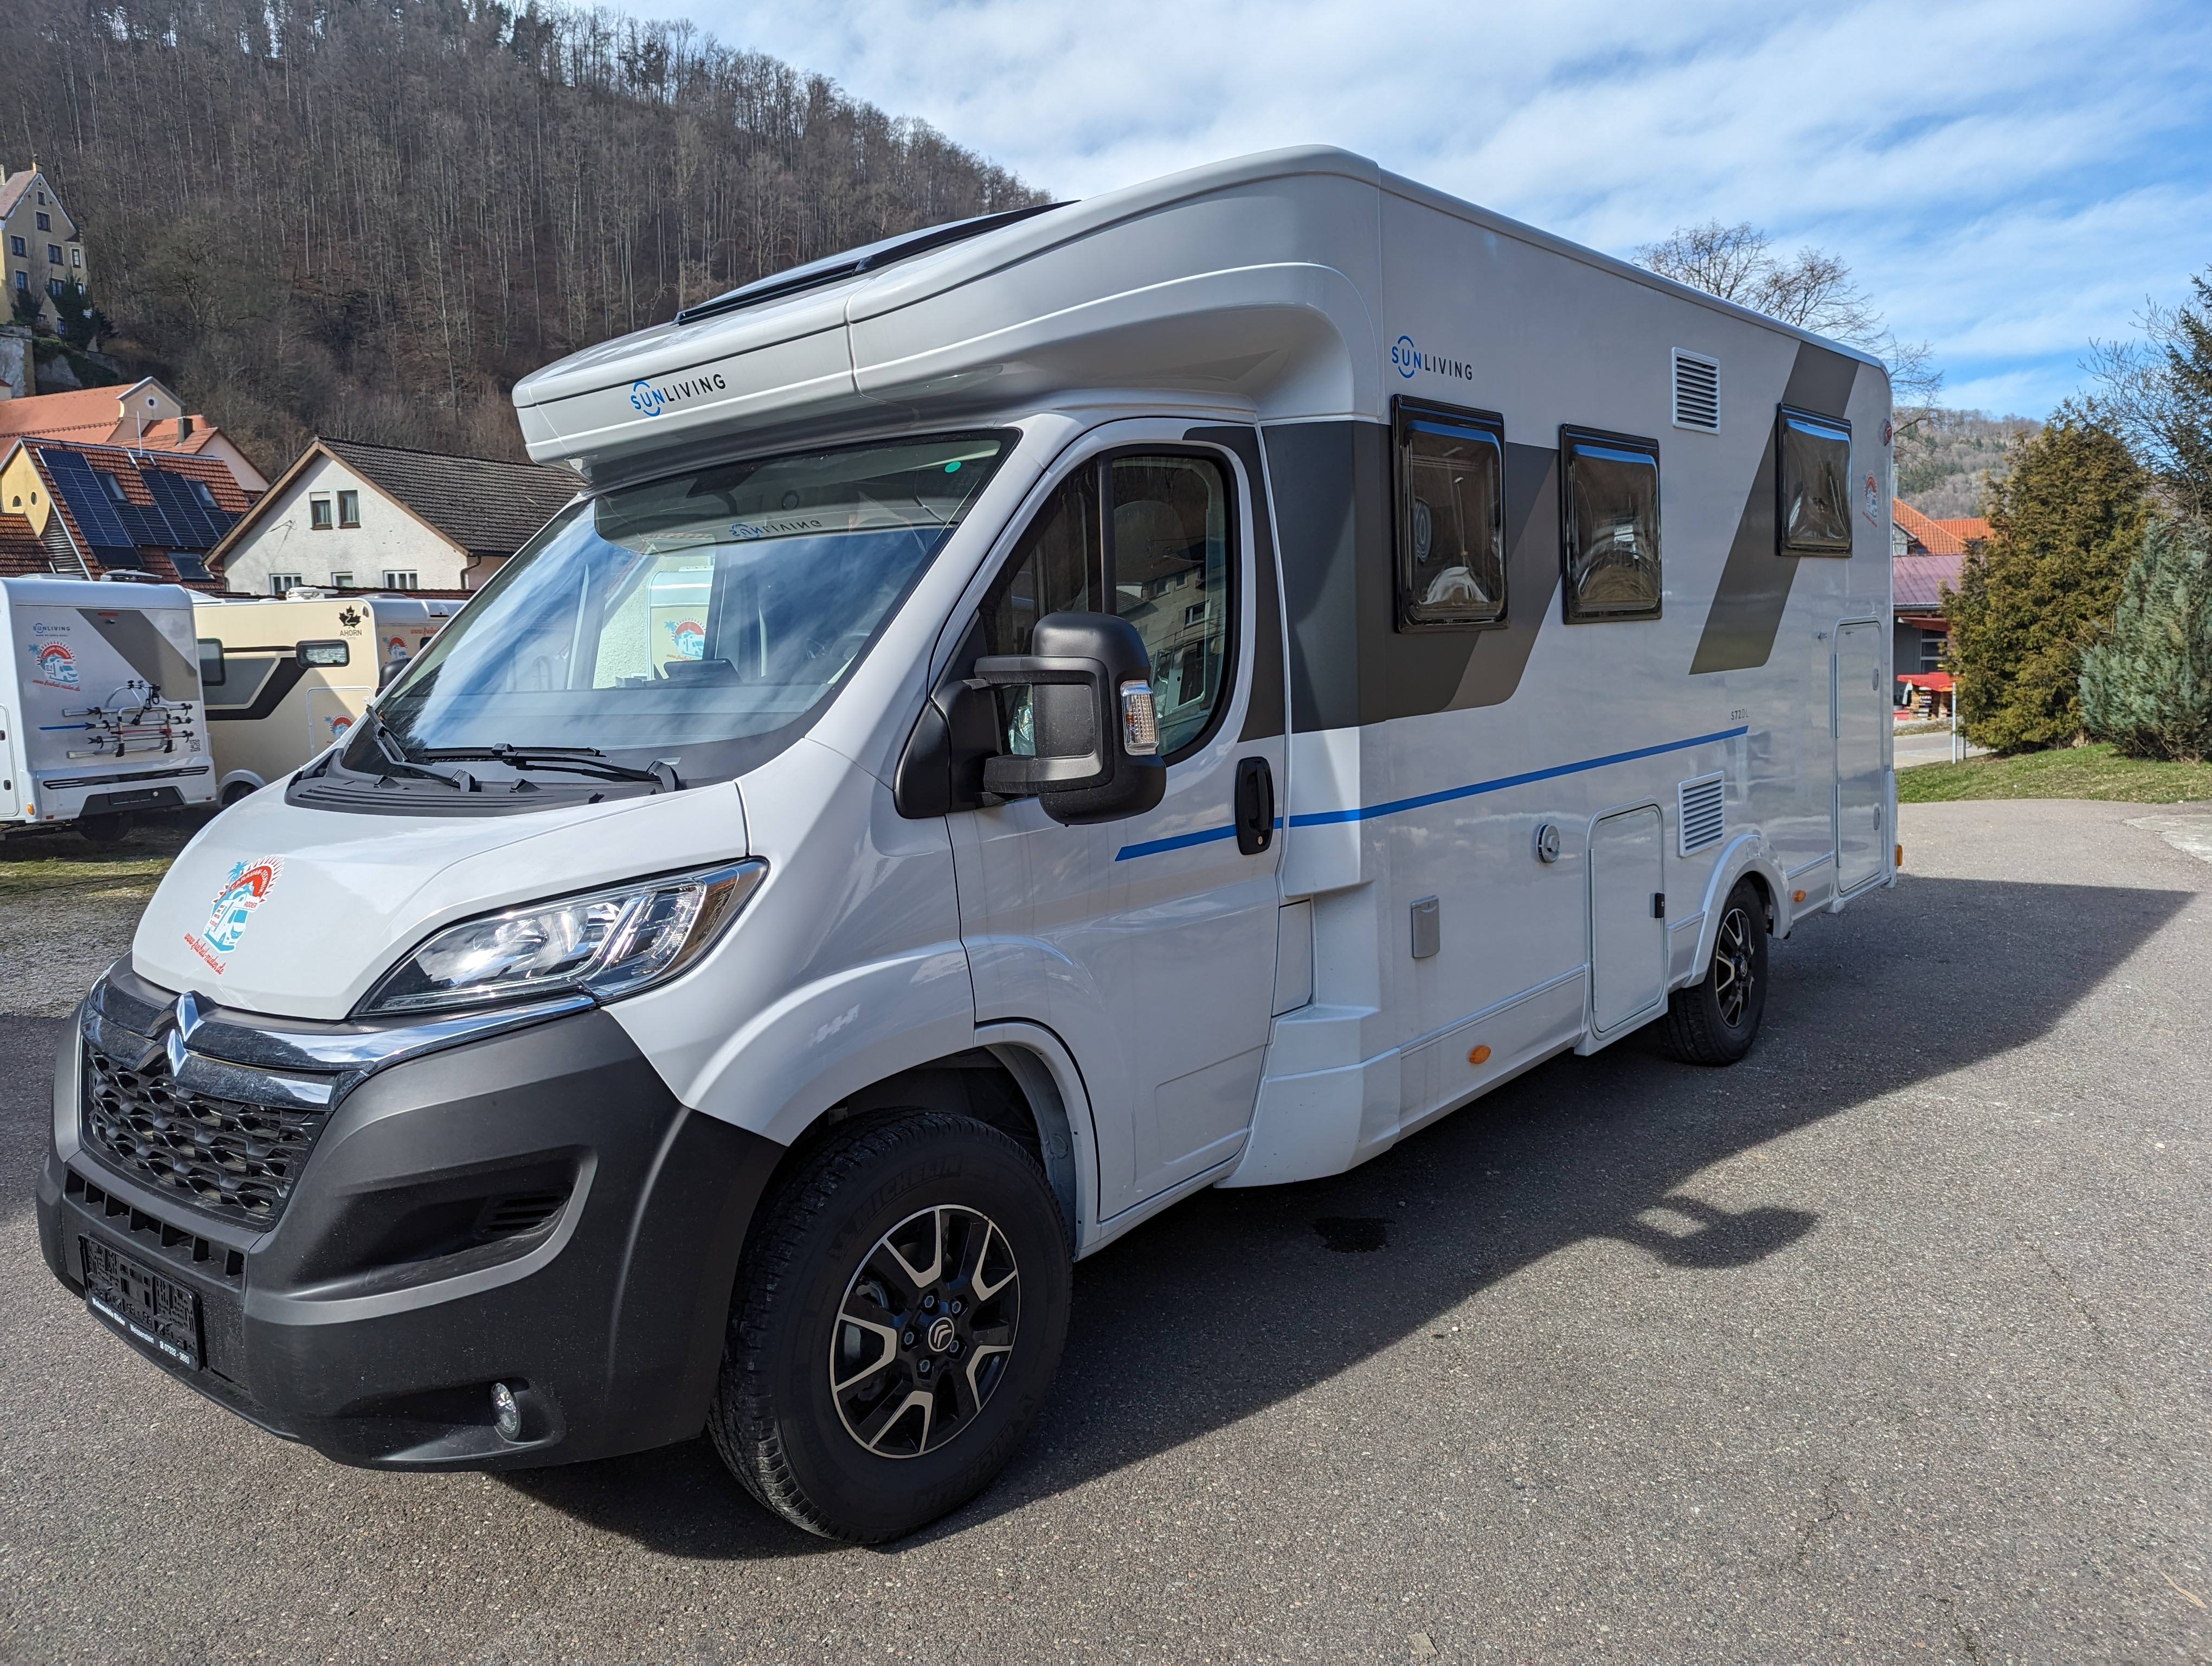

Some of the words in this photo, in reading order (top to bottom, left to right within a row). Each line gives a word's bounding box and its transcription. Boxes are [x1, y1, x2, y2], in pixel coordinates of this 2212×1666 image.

[1391, 345, 1472, 381] SUNLIVING
[630, 373, 726, 411] SUNLIVING
[231, 869, 268, 894] CARAVAN-TECHNIK
[183, 932, 227, 975] www.freiheit-mieten.de
